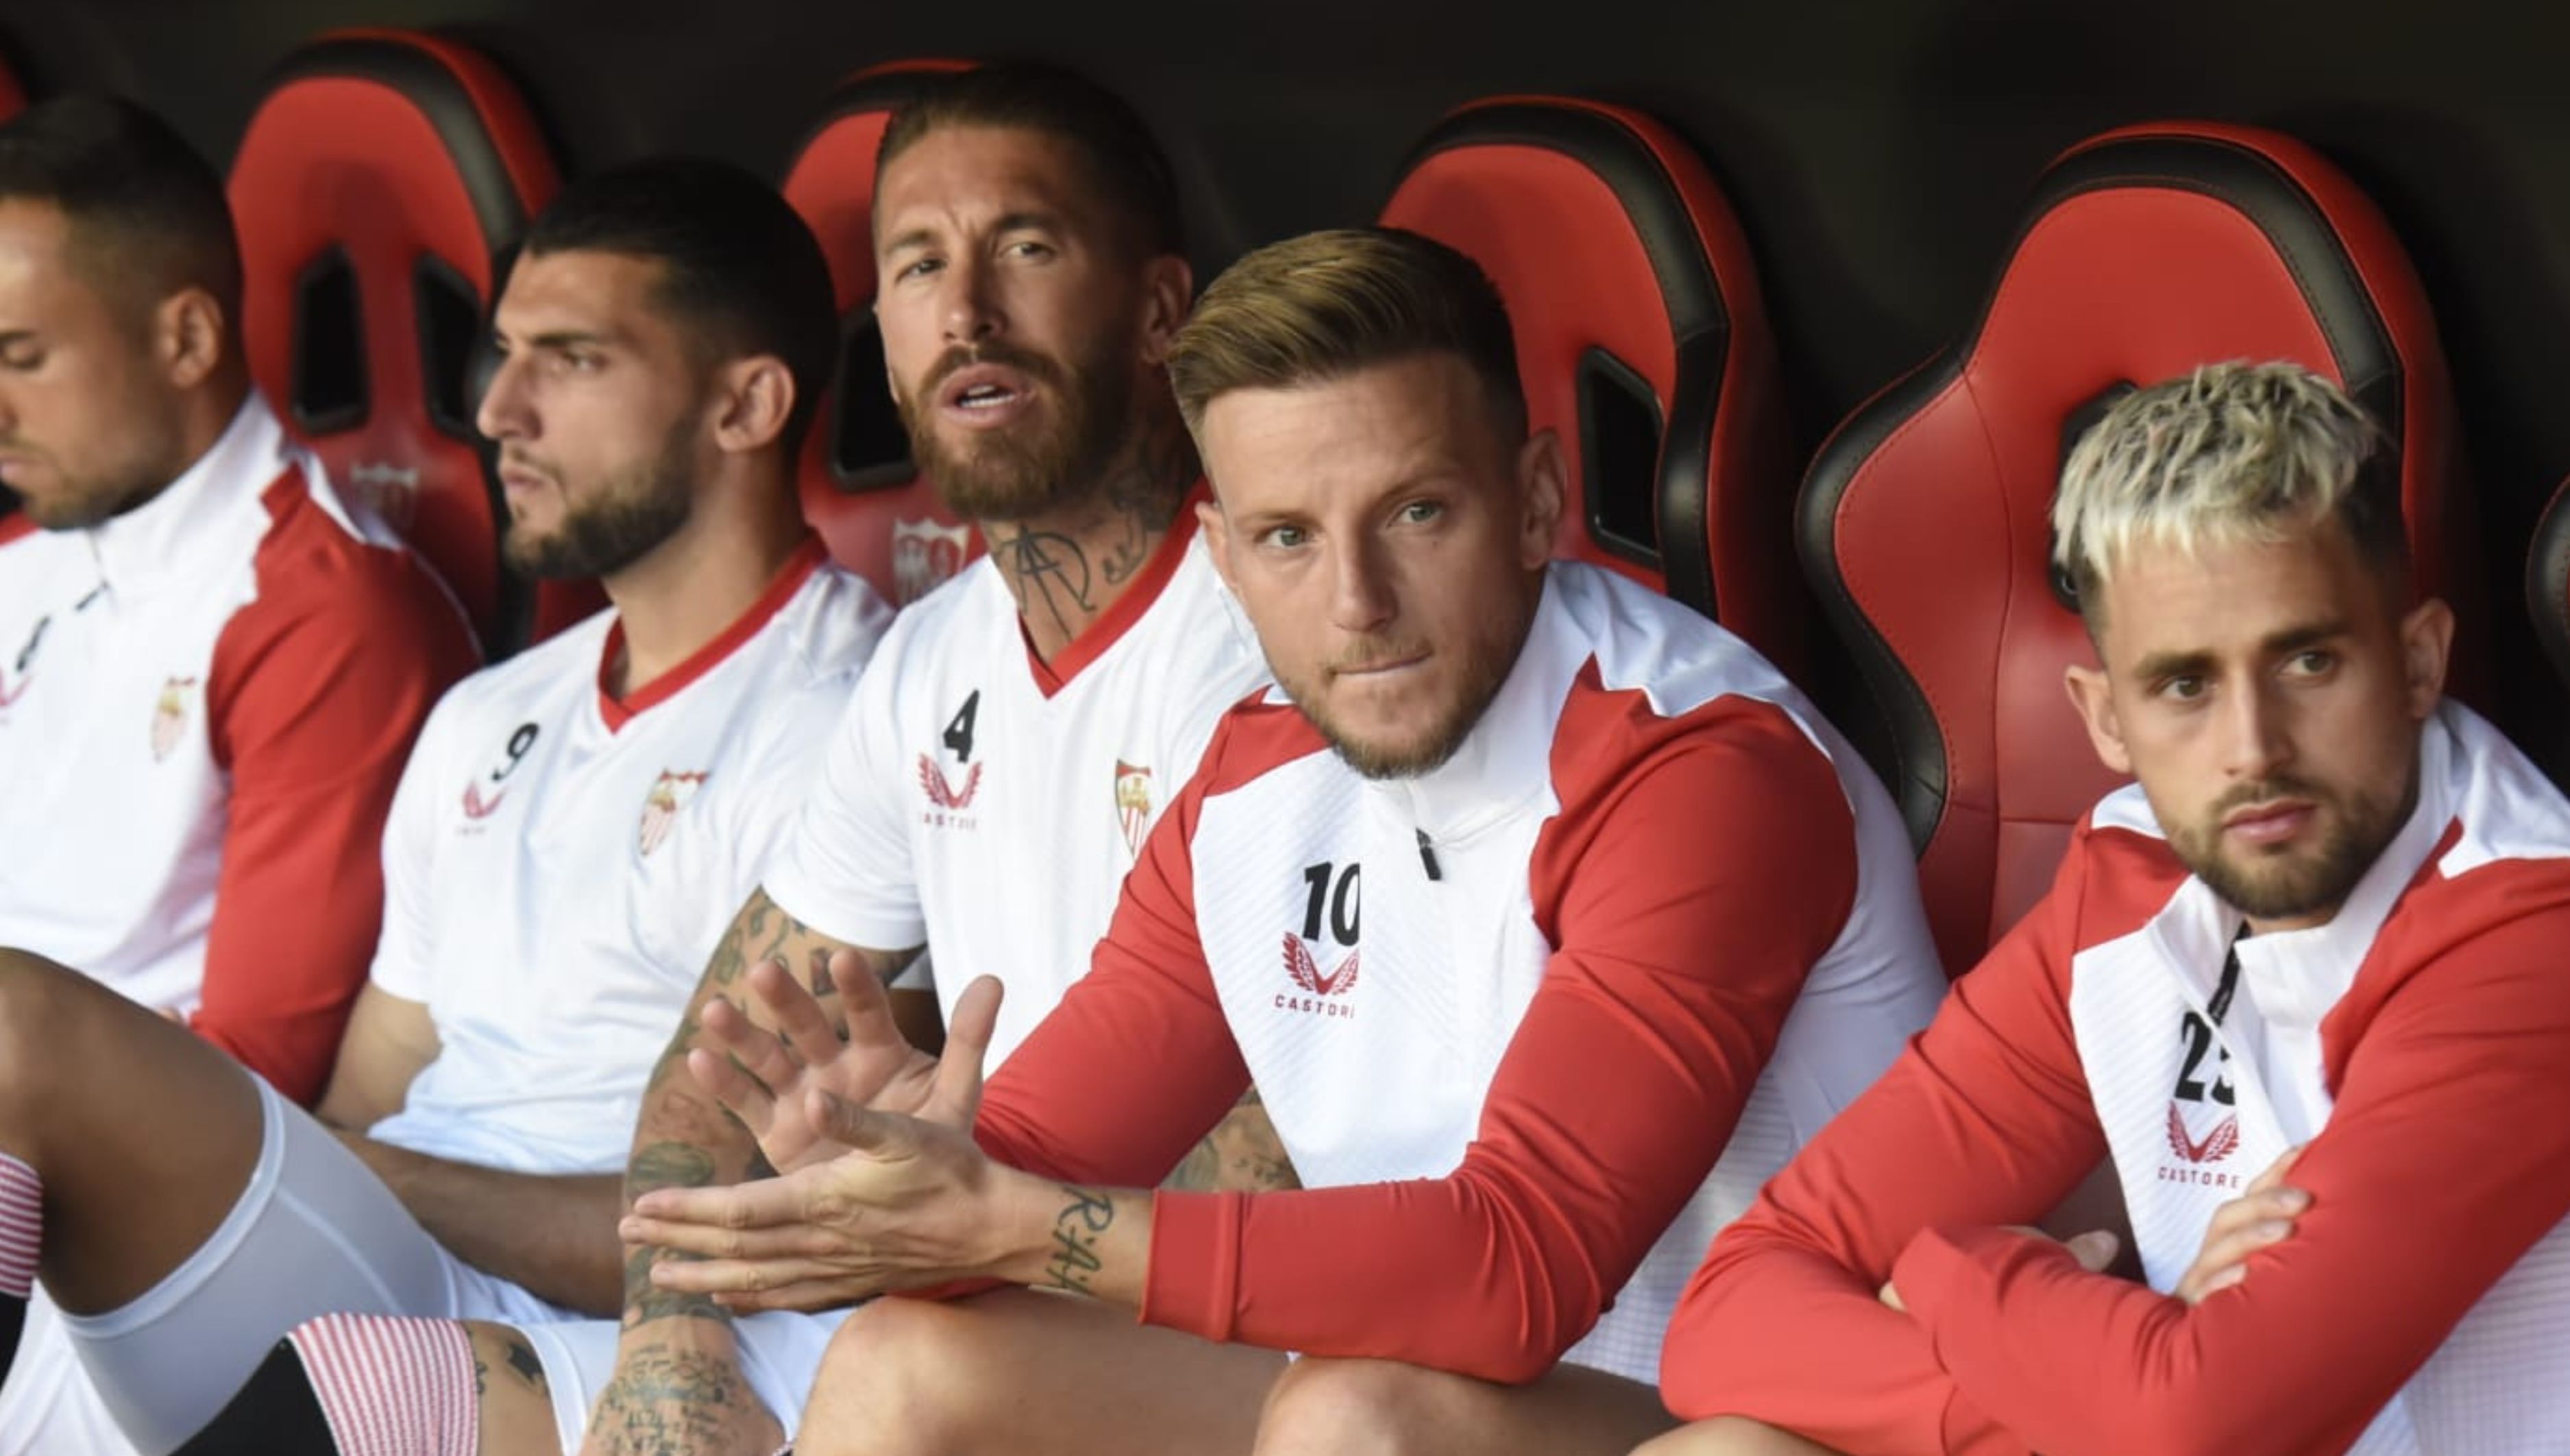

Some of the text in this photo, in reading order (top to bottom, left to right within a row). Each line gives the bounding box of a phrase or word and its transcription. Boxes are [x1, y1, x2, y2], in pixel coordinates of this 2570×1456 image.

[492, 723, 539, 782] 9
[944, 688, 980, 763] 4
[1302, 861, 1360, 946] 10
[2158, 1166, 2238, 1189] CASTORE
